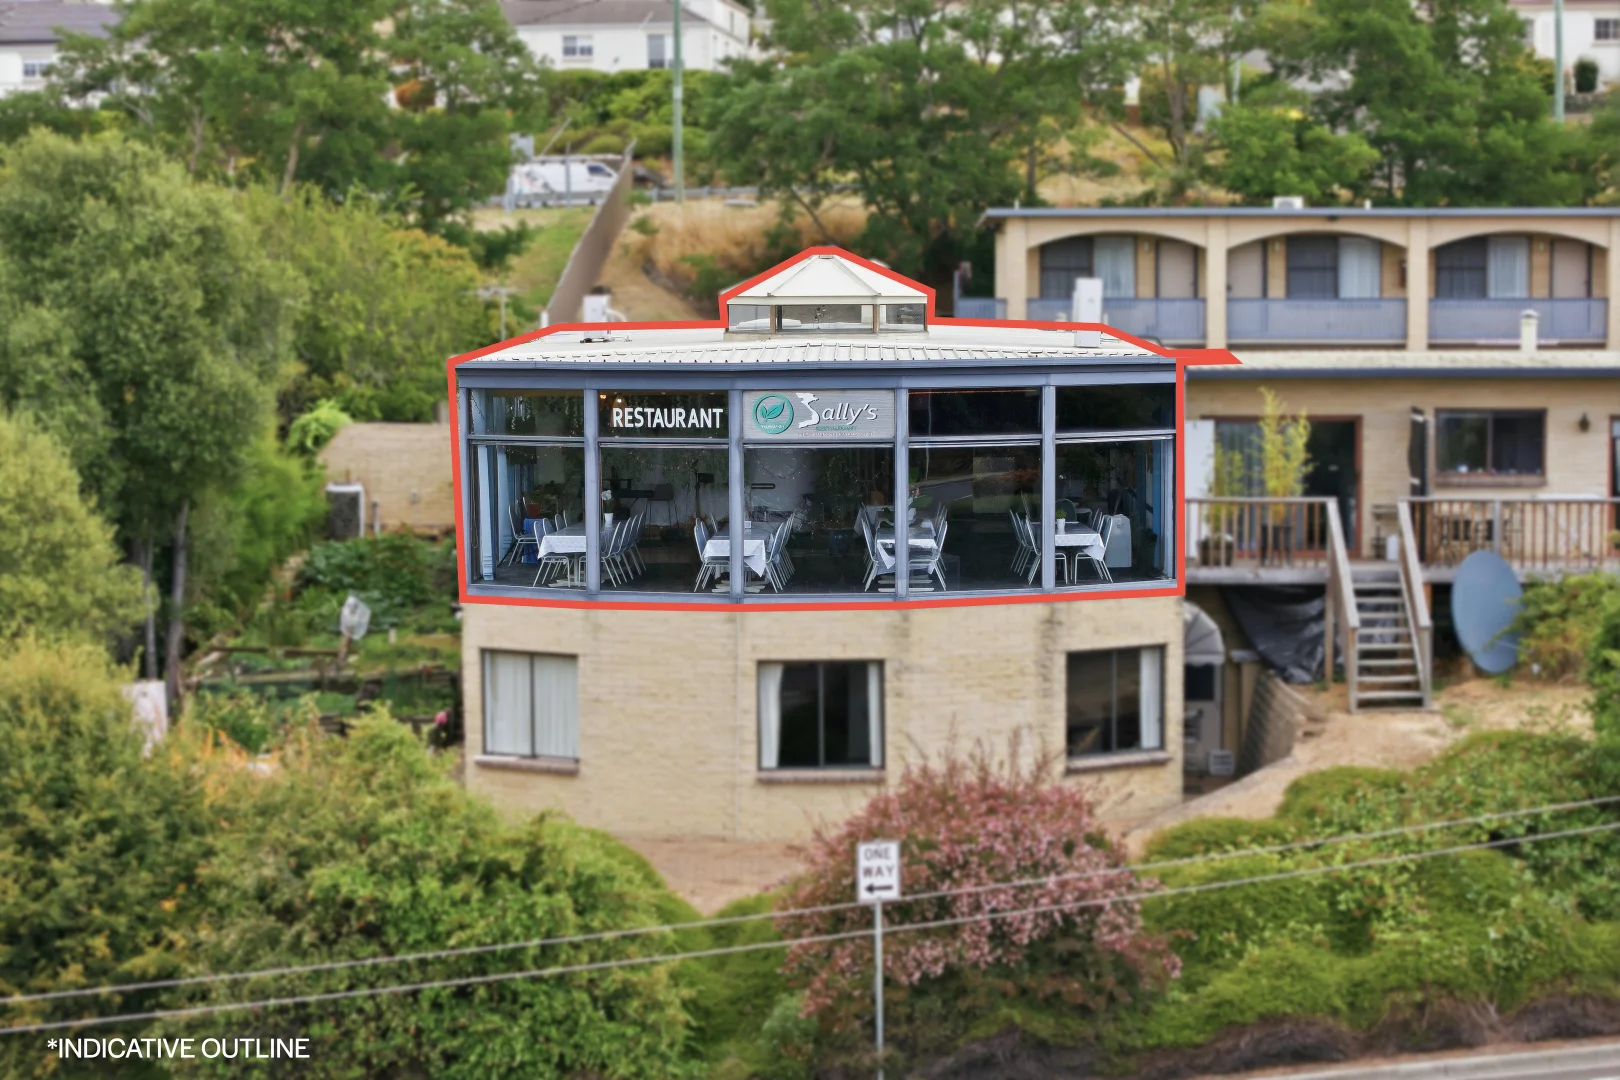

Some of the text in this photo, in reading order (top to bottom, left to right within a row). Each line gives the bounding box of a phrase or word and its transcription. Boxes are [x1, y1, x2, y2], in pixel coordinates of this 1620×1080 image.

[612, 407, 724, 429] RESTAURANT
[795, 392, 878, 429] Sally's
[863, 847, 892, 861] ONE
[863, 865, 895, 878] WAY
